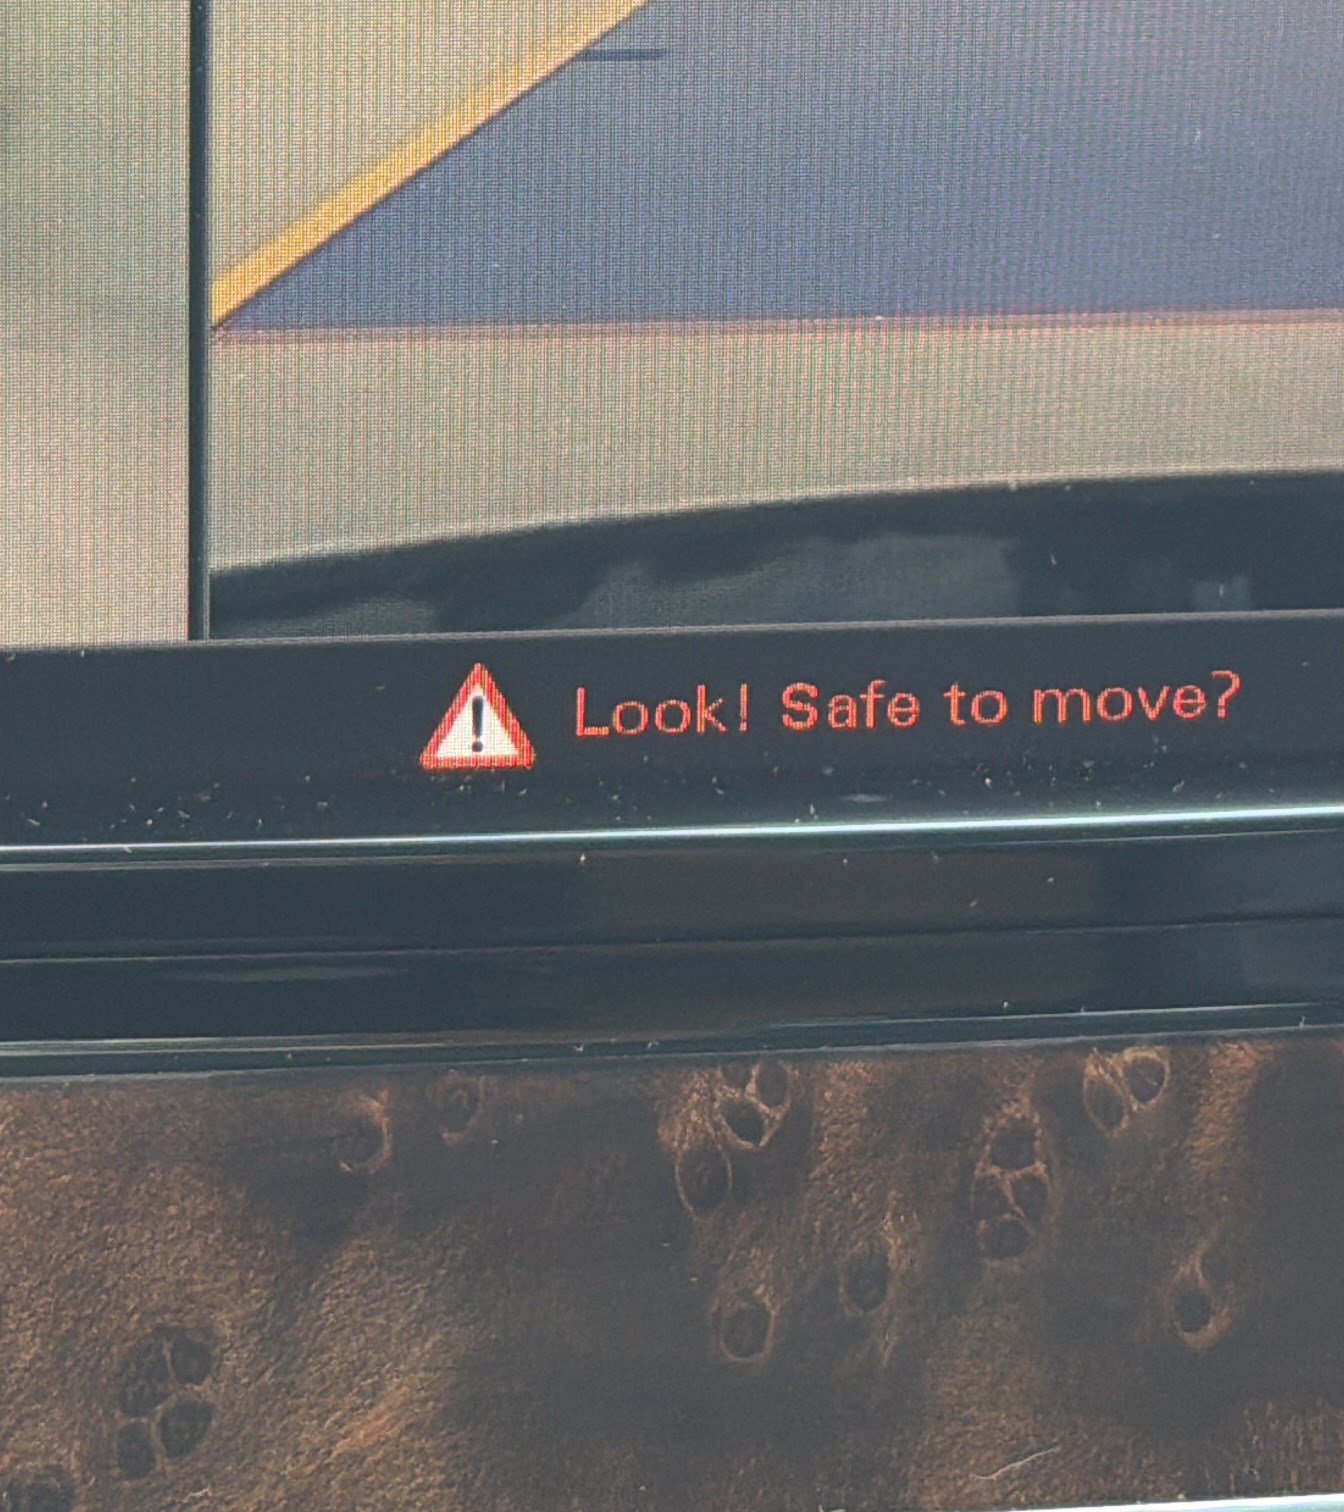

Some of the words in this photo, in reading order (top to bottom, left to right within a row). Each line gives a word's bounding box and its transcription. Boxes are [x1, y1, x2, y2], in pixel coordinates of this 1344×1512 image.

[575, 683, 749, 738] Look!
[780, 679, 921, 732] Safe
[943, 682, 1010, 728] to
[1031, 668, 1243, 725] move?
